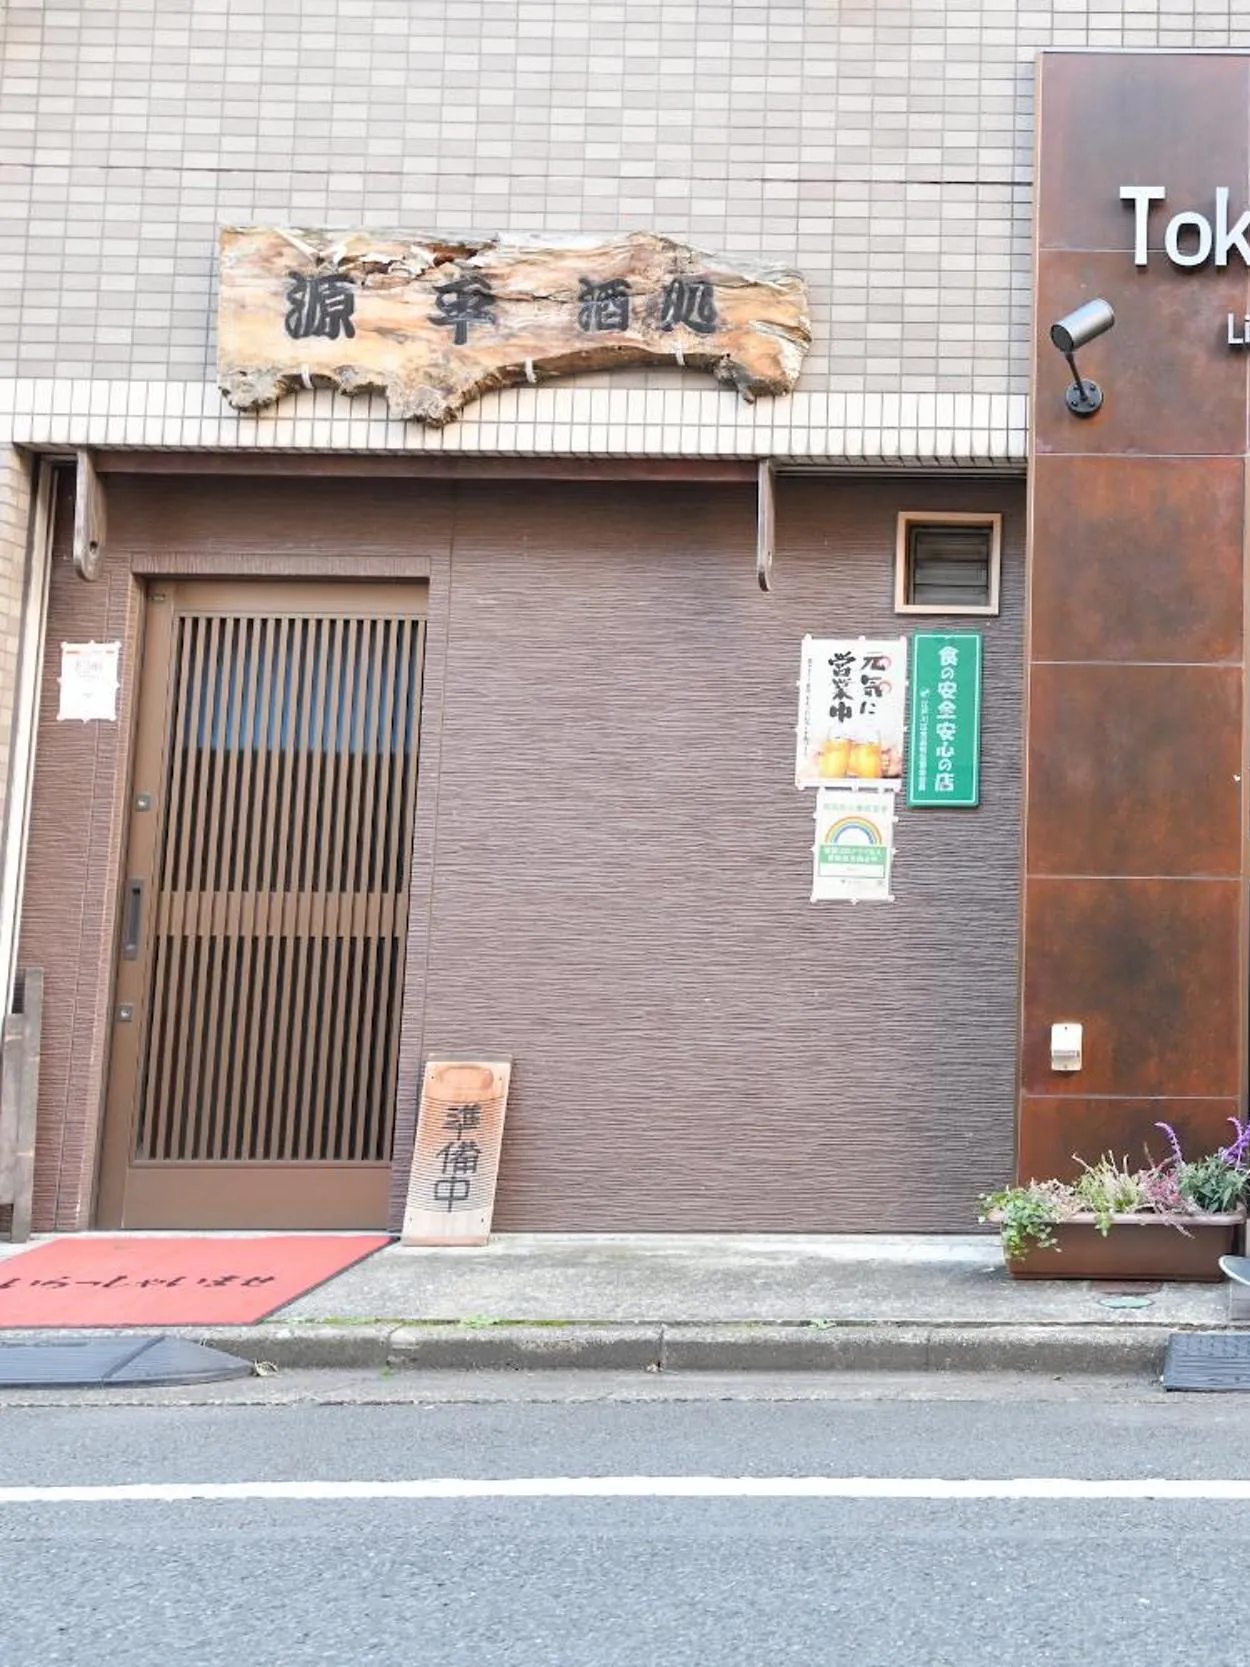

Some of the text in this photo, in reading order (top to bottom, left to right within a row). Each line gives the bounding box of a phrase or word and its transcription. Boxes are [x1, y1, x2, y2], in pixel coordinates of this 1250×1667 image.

[828, 651, 856, 723] 営業中
[935, 645, 960, 793] 食の安全安心の店
[433, 1104, 483, 1213] 準備中
